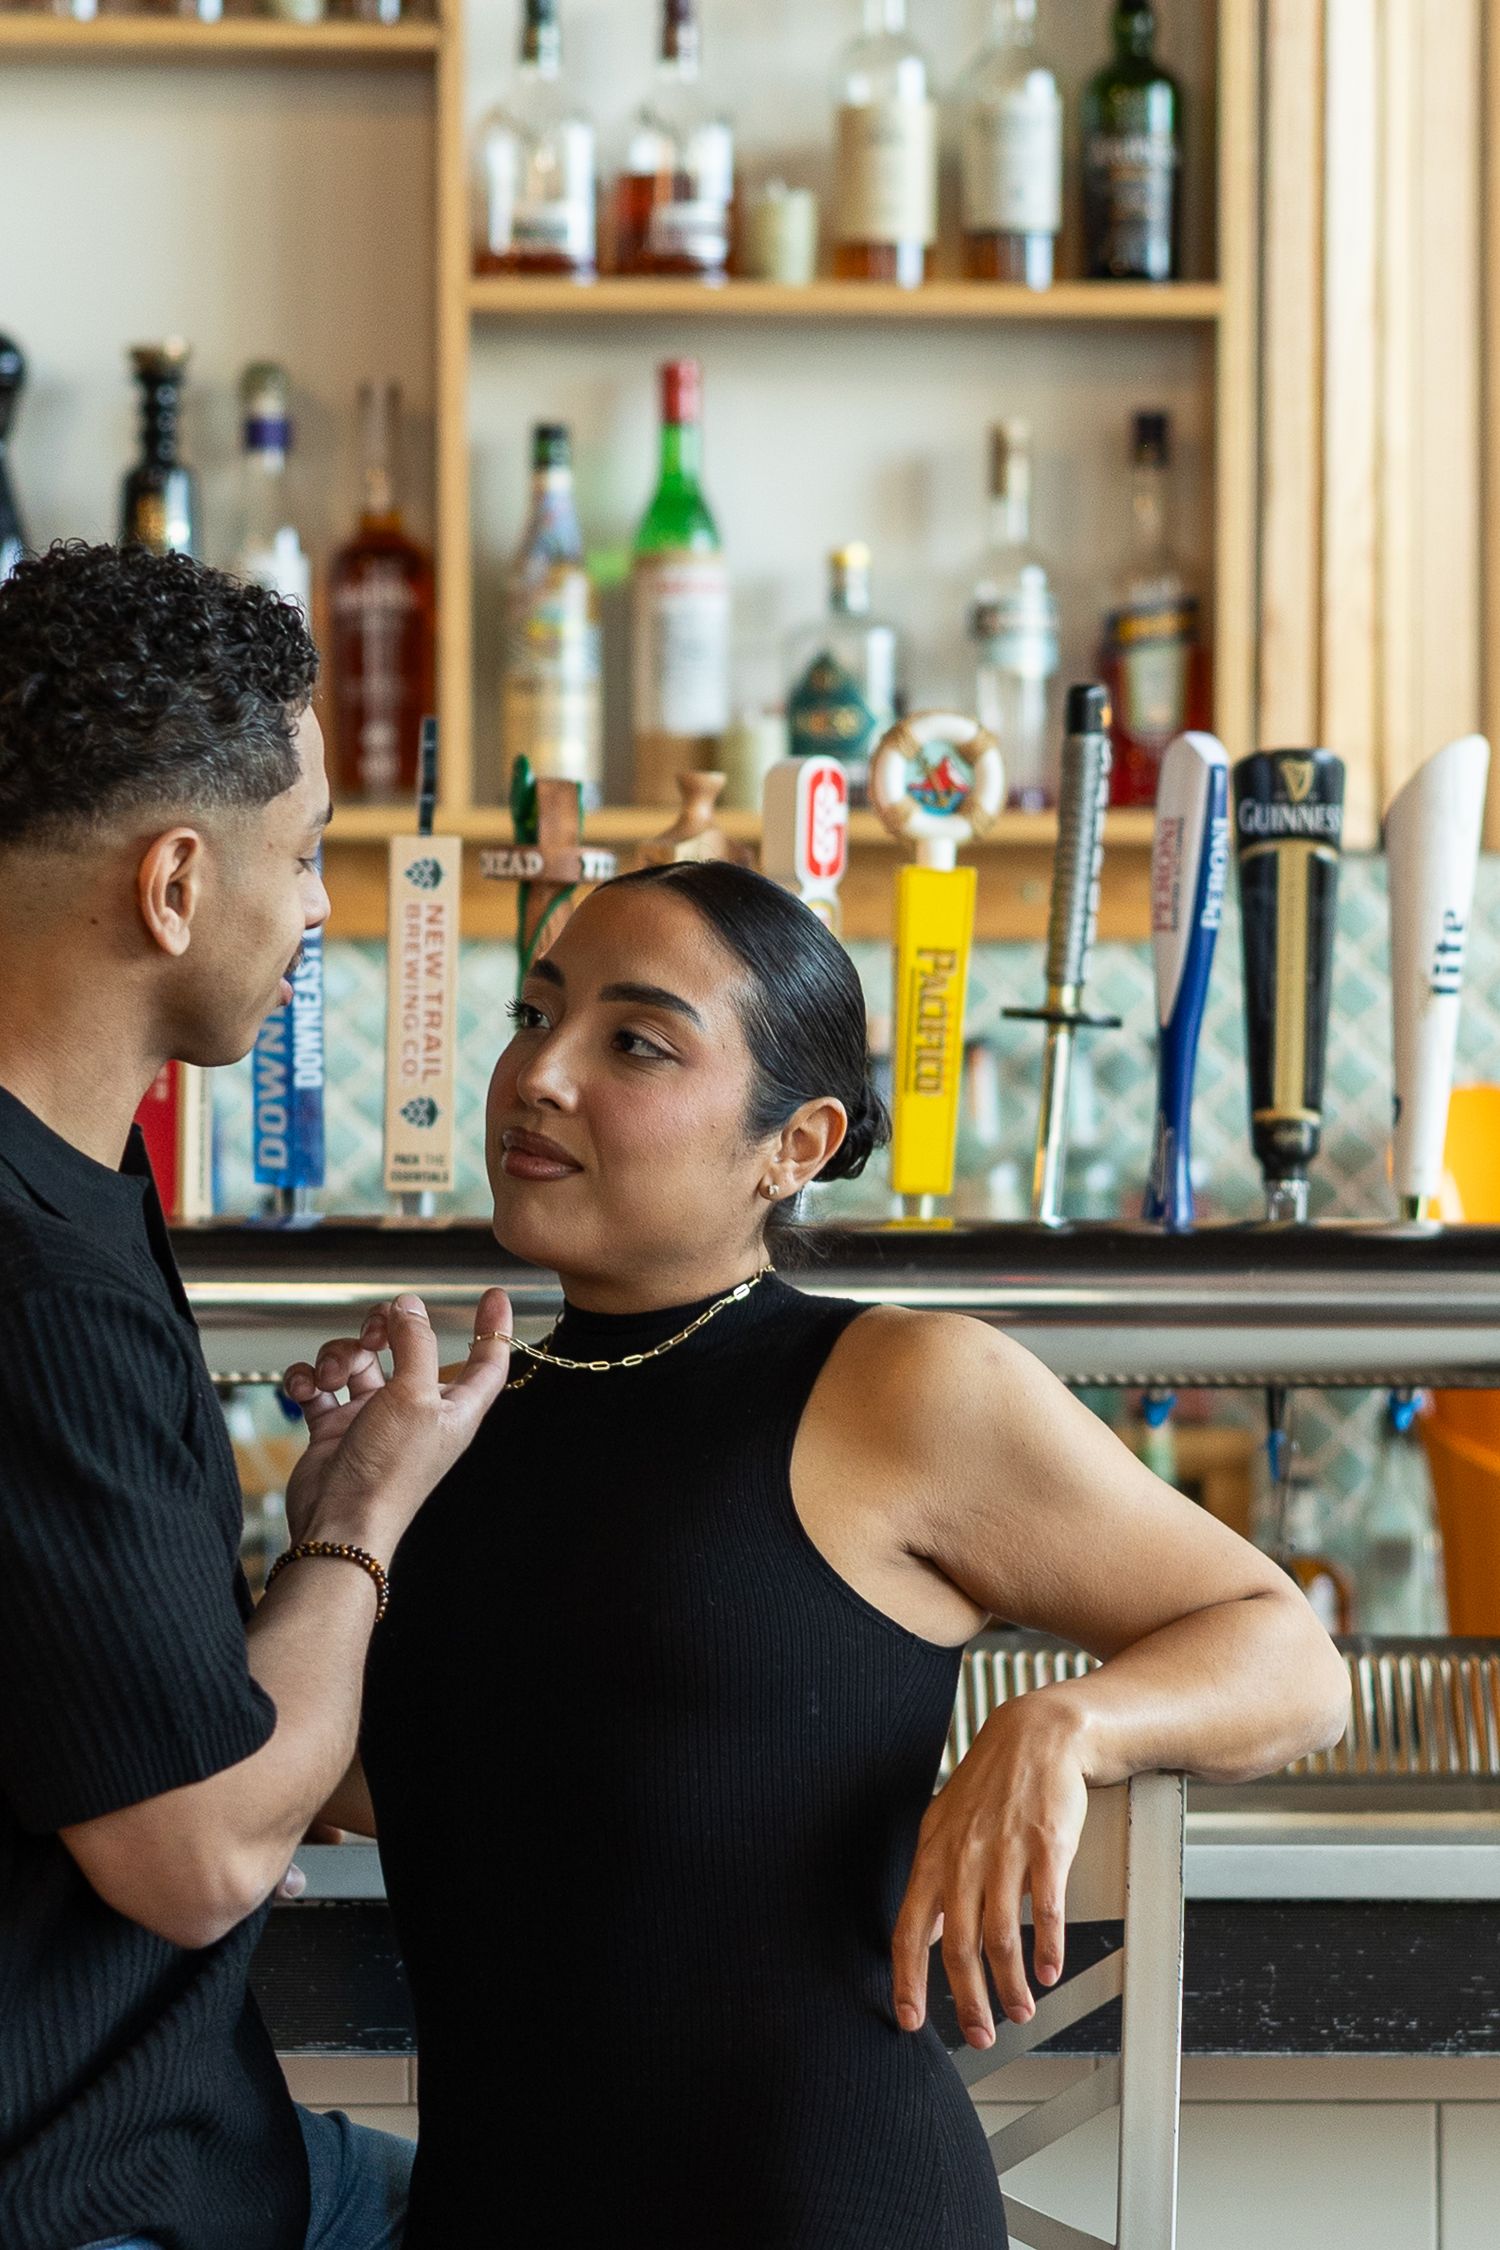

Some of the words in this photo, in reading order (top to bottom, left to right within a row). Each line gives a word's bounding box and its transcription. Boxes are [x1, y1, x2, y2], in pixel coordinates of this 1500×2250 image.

[1200, 817, 1229, 930] PERONI
[402, 904, 421, 1032] BREWING
[424, 904, 445, 979] NEW
[421, 991, 444, 1085] TRAIL
[914, 946, 958, 1095] PACIFICO
